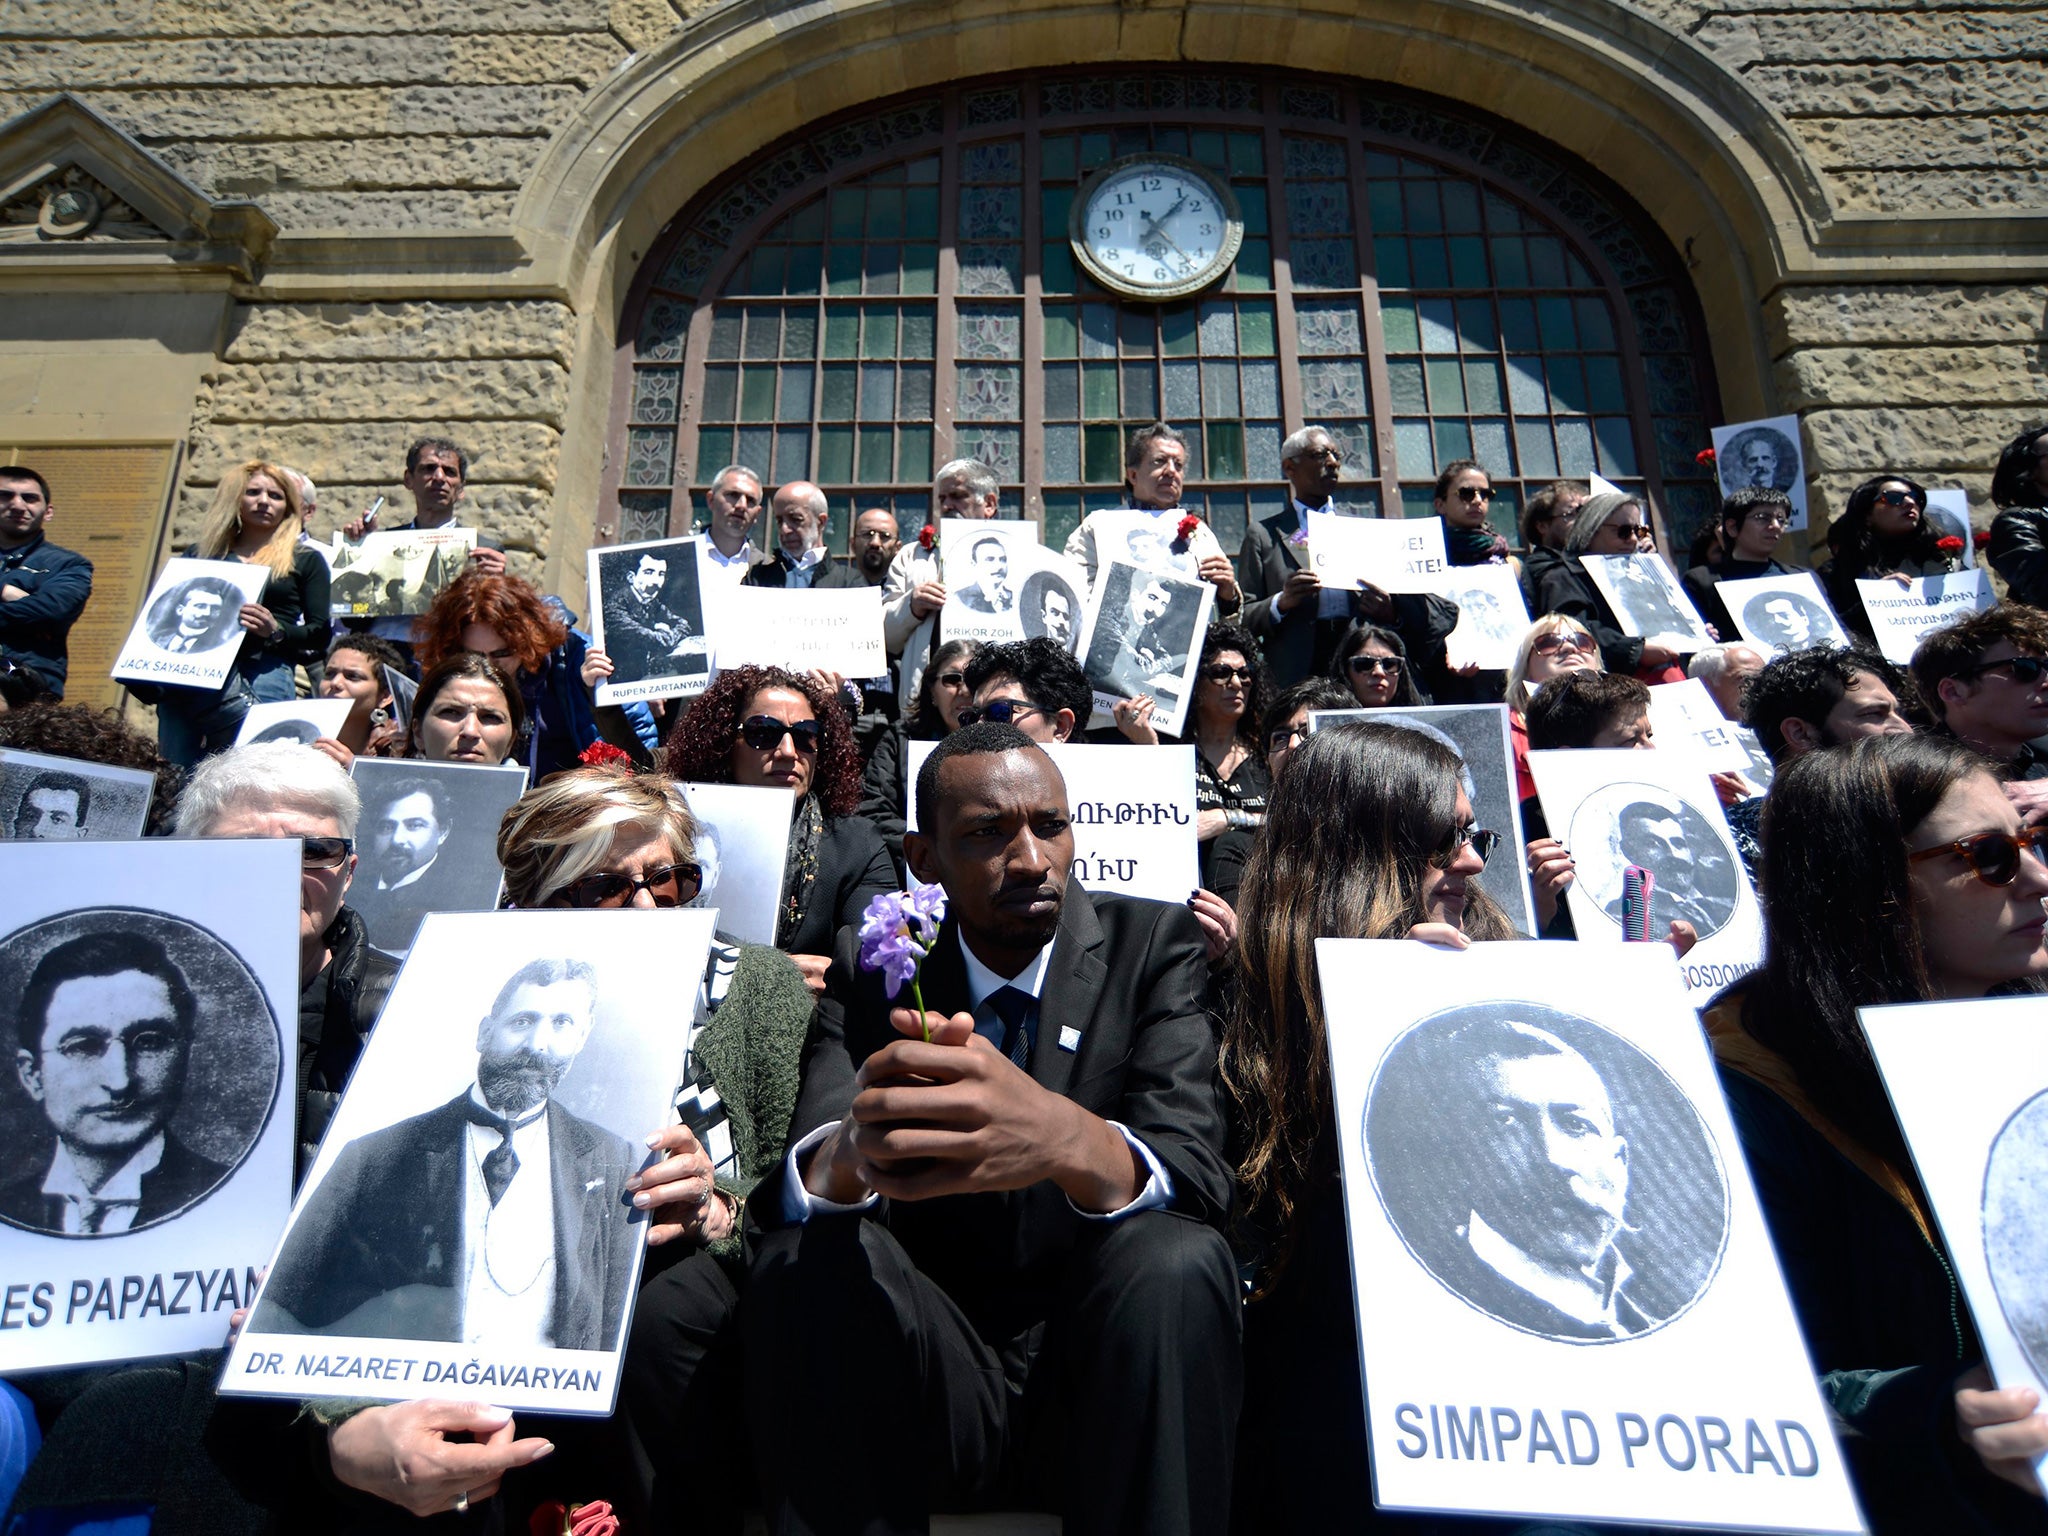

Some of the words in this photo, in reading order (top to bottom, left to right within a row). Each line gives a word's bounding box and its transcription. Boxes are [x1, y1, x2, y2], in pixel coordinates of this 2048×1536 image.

[1141, 179, 1161, 192] 12
[1115, 192, 1135, 205] 11
[1175, 187, 1183, 199] 1
[1190, 200, 1202, 212] 2
[1104, 208, 1124, 222] 10
[1099, 227, 1111, 239] 9
[1200, 223, 1212, 236] 3
[1107, 248, 1119, 260] 8
[1193, 247, 1205, 258] 4
[1124, 264, 1135, 276] 7
[1154, 267, 1167, 280] 6
[121, 659, 150, 671] JACK
[153, 661, 224, 679] SAYABALYAN
[613, 687, 646, 698] RUPEN
[649, 680, 706, 694] ZARTANYAN
[1071, 802, 1190, 825] ՈՒԹԻՒՆ
[246, 1352, 285, 1375] DR.
[296, 1354, 417, 1382] NAZARET
[423, 1358, 602, 1392] DAĞAVARYAN
[1394, 1402, 1600, 1467] SIMPAD
[1615, 1412, 1820, 1478] PORAD
